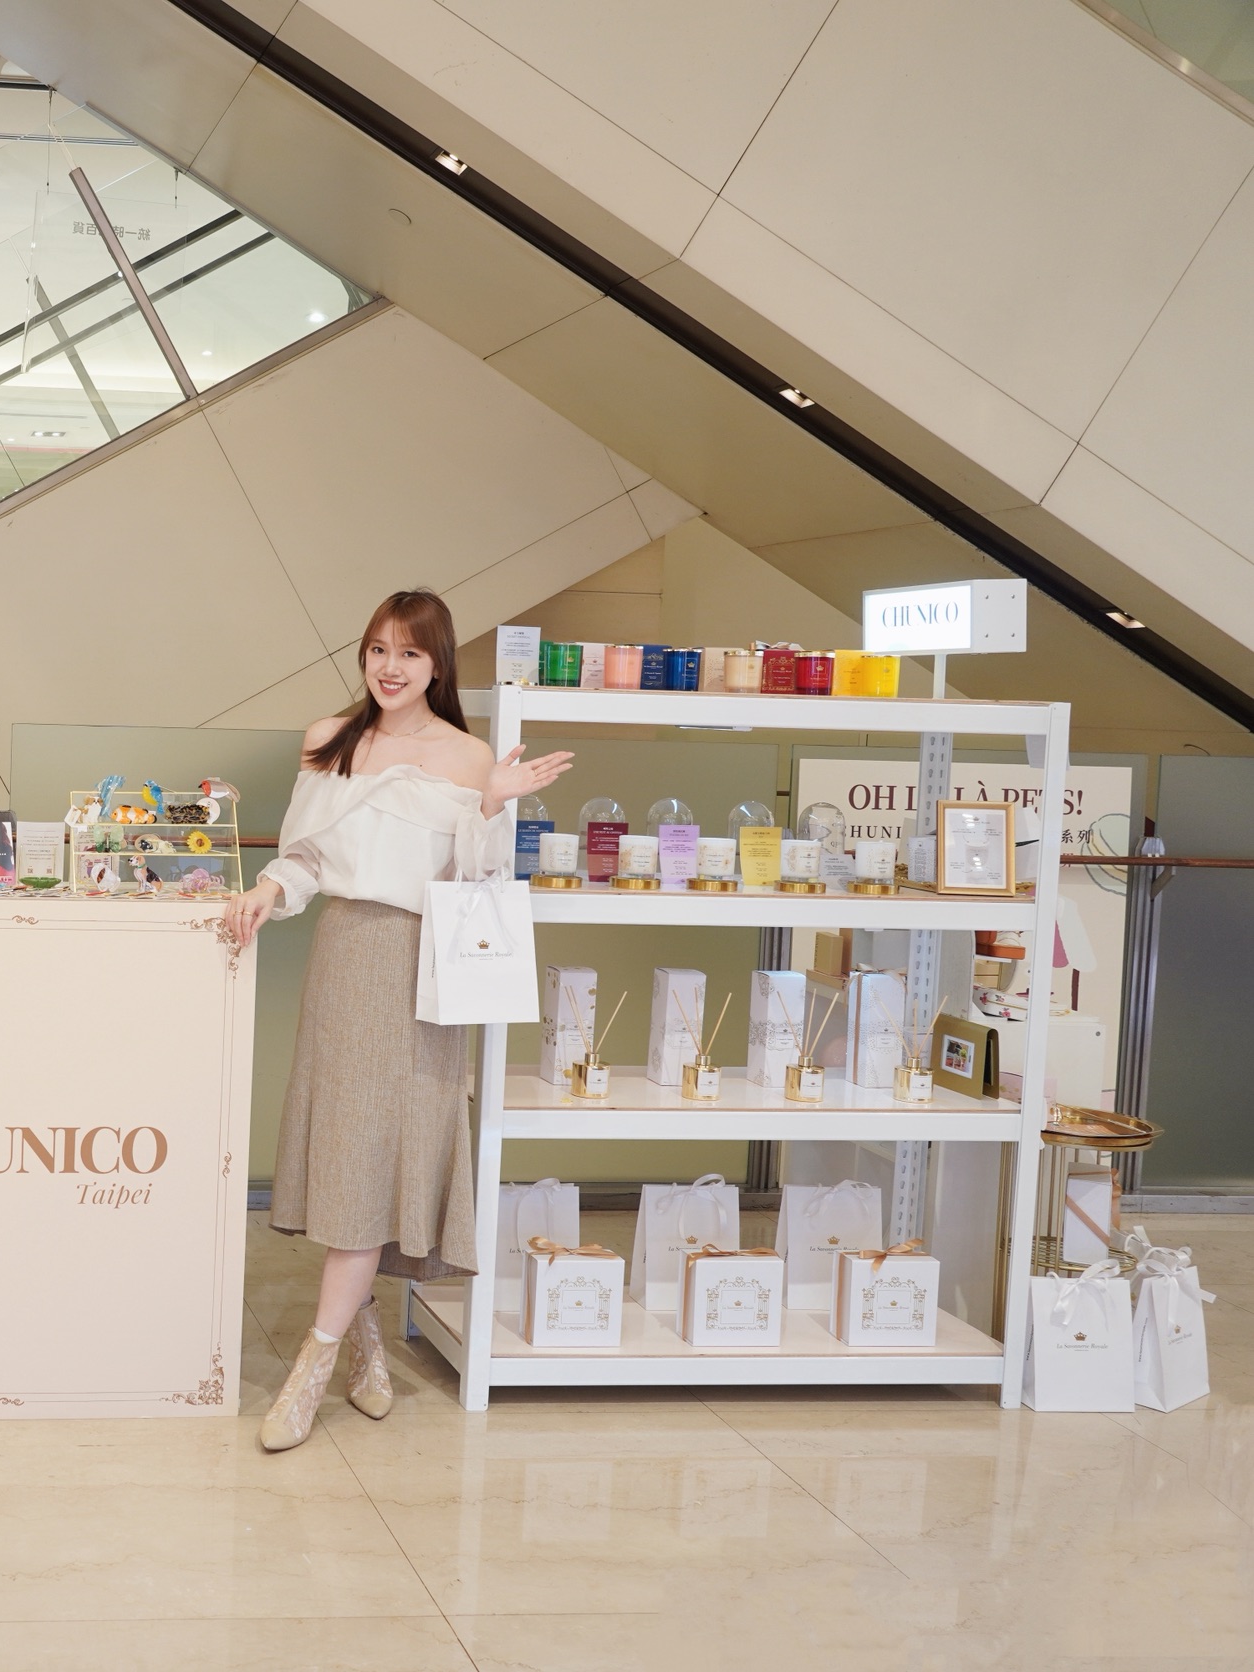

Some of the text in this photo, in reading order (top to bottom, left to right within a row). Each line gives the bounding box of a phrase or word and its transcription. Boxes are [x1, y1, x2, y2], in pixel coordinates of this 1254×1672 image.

[882, 601, 959, 628] CHUNICO
[848, 784, 897, 811] OH
[75, 1181, 154, 1210] Taipei
